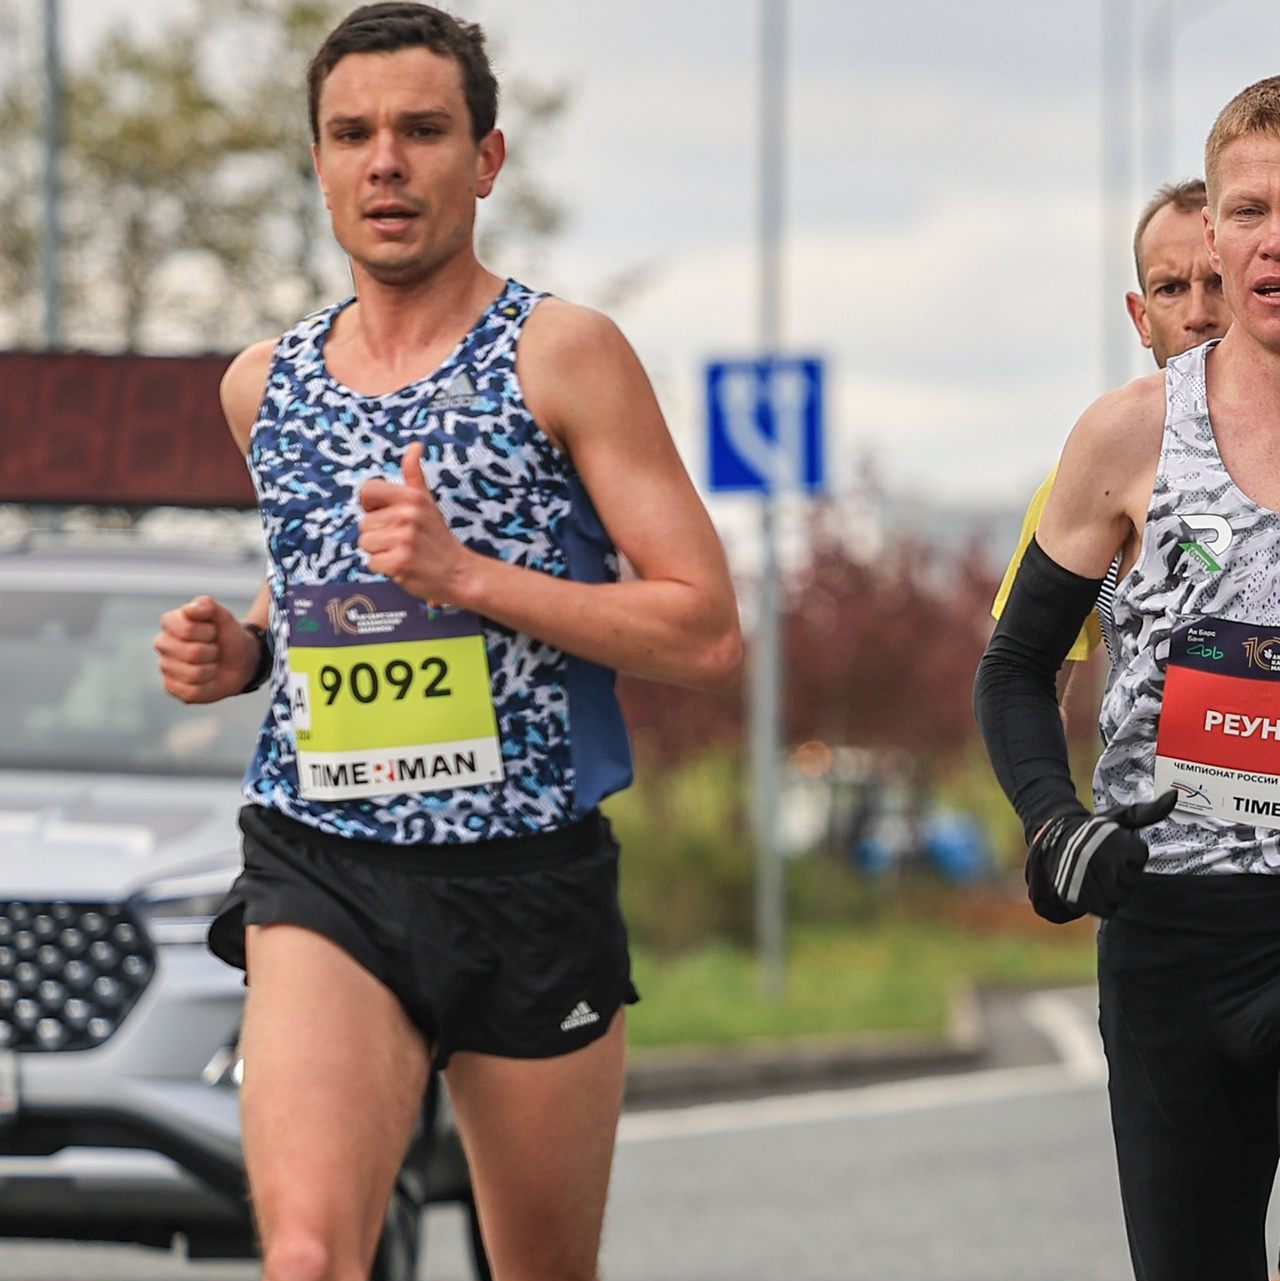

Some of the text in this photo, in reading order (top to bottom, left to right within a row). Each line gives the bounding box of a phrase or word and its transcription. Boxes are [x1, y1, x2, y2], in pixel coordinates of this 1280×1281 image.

[320, 657, 452, 705] 9092
[1174, 762, 1235, 780] ЧЕМПИОНАТ
[1237, 773, 1278, 785] РОССИИ
